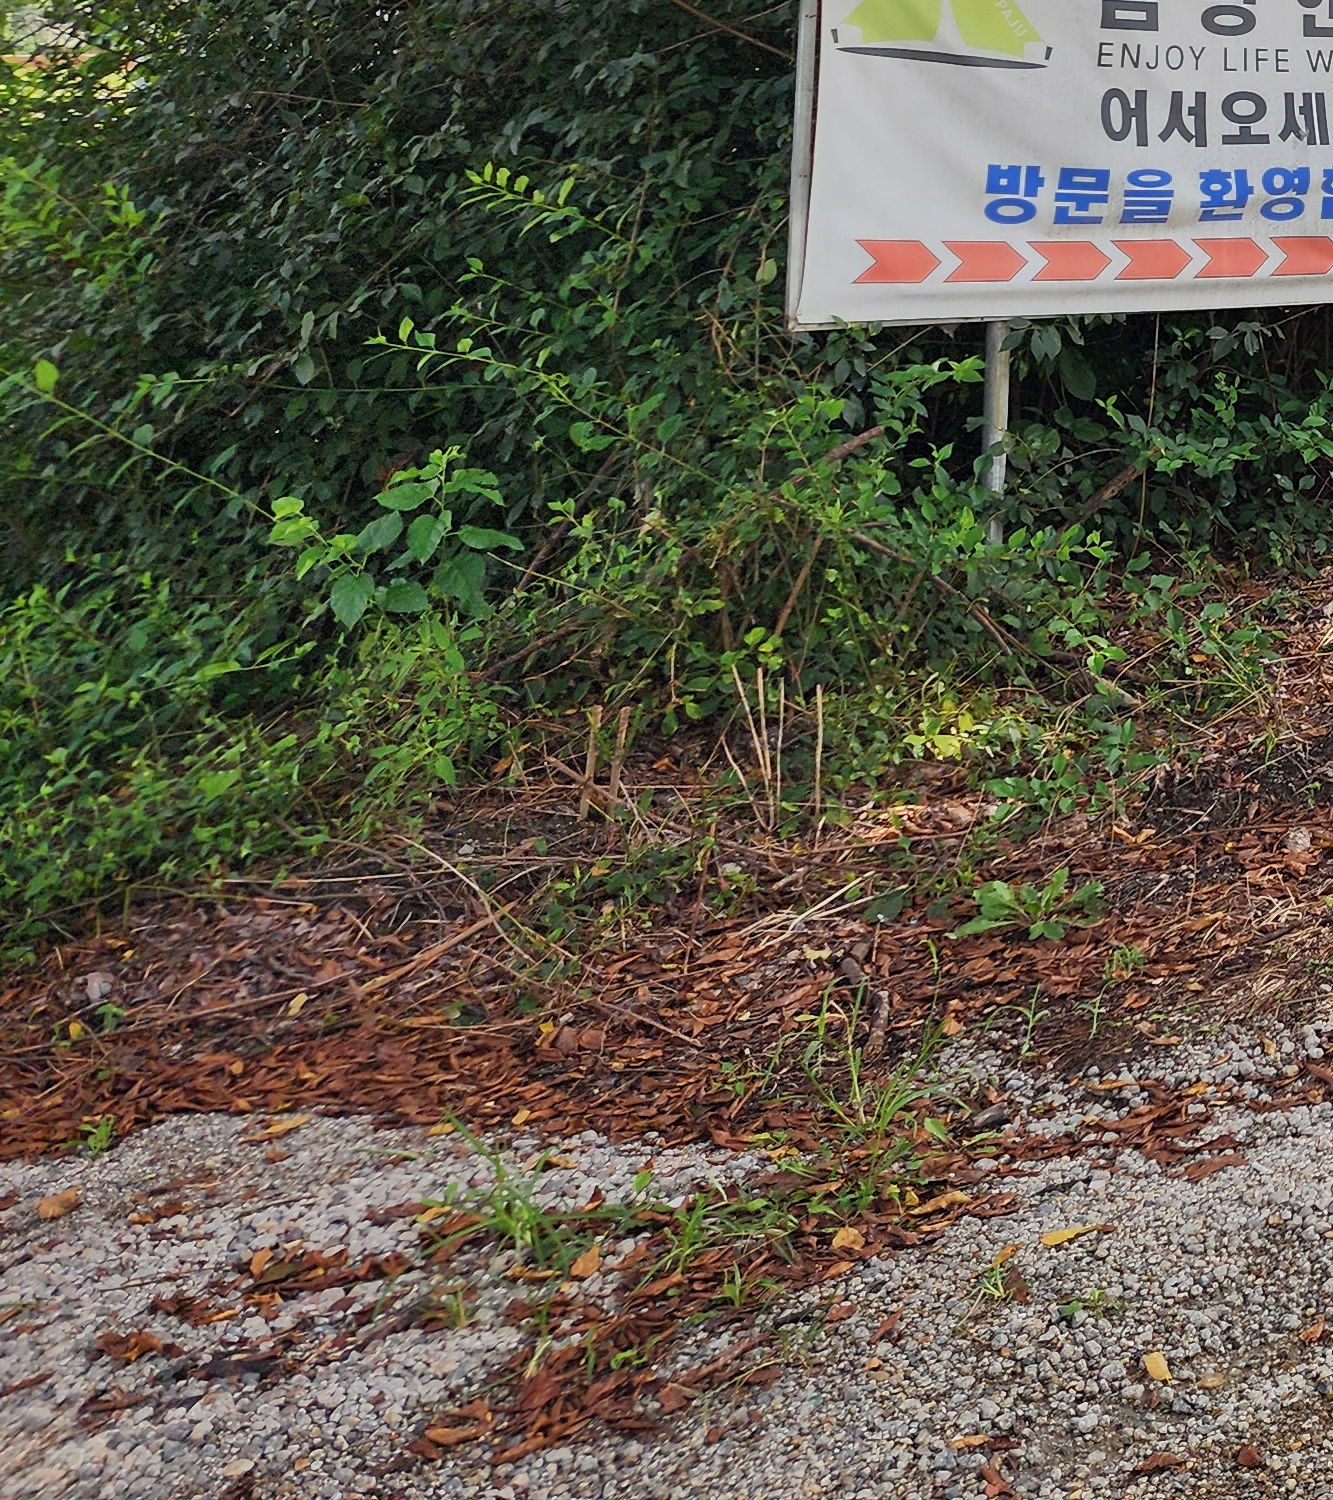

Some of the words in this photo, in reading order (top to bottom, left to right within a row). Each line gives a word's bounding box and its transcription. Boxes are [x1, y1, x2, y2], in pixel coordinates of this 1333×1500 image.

[995, 0, 1028, 37] PAJU
[1096, 41, 1207, 71] ENJOY
[1222, 48, 1290, 73] LIFE
[982, 163, 1176, 225] 방문을
